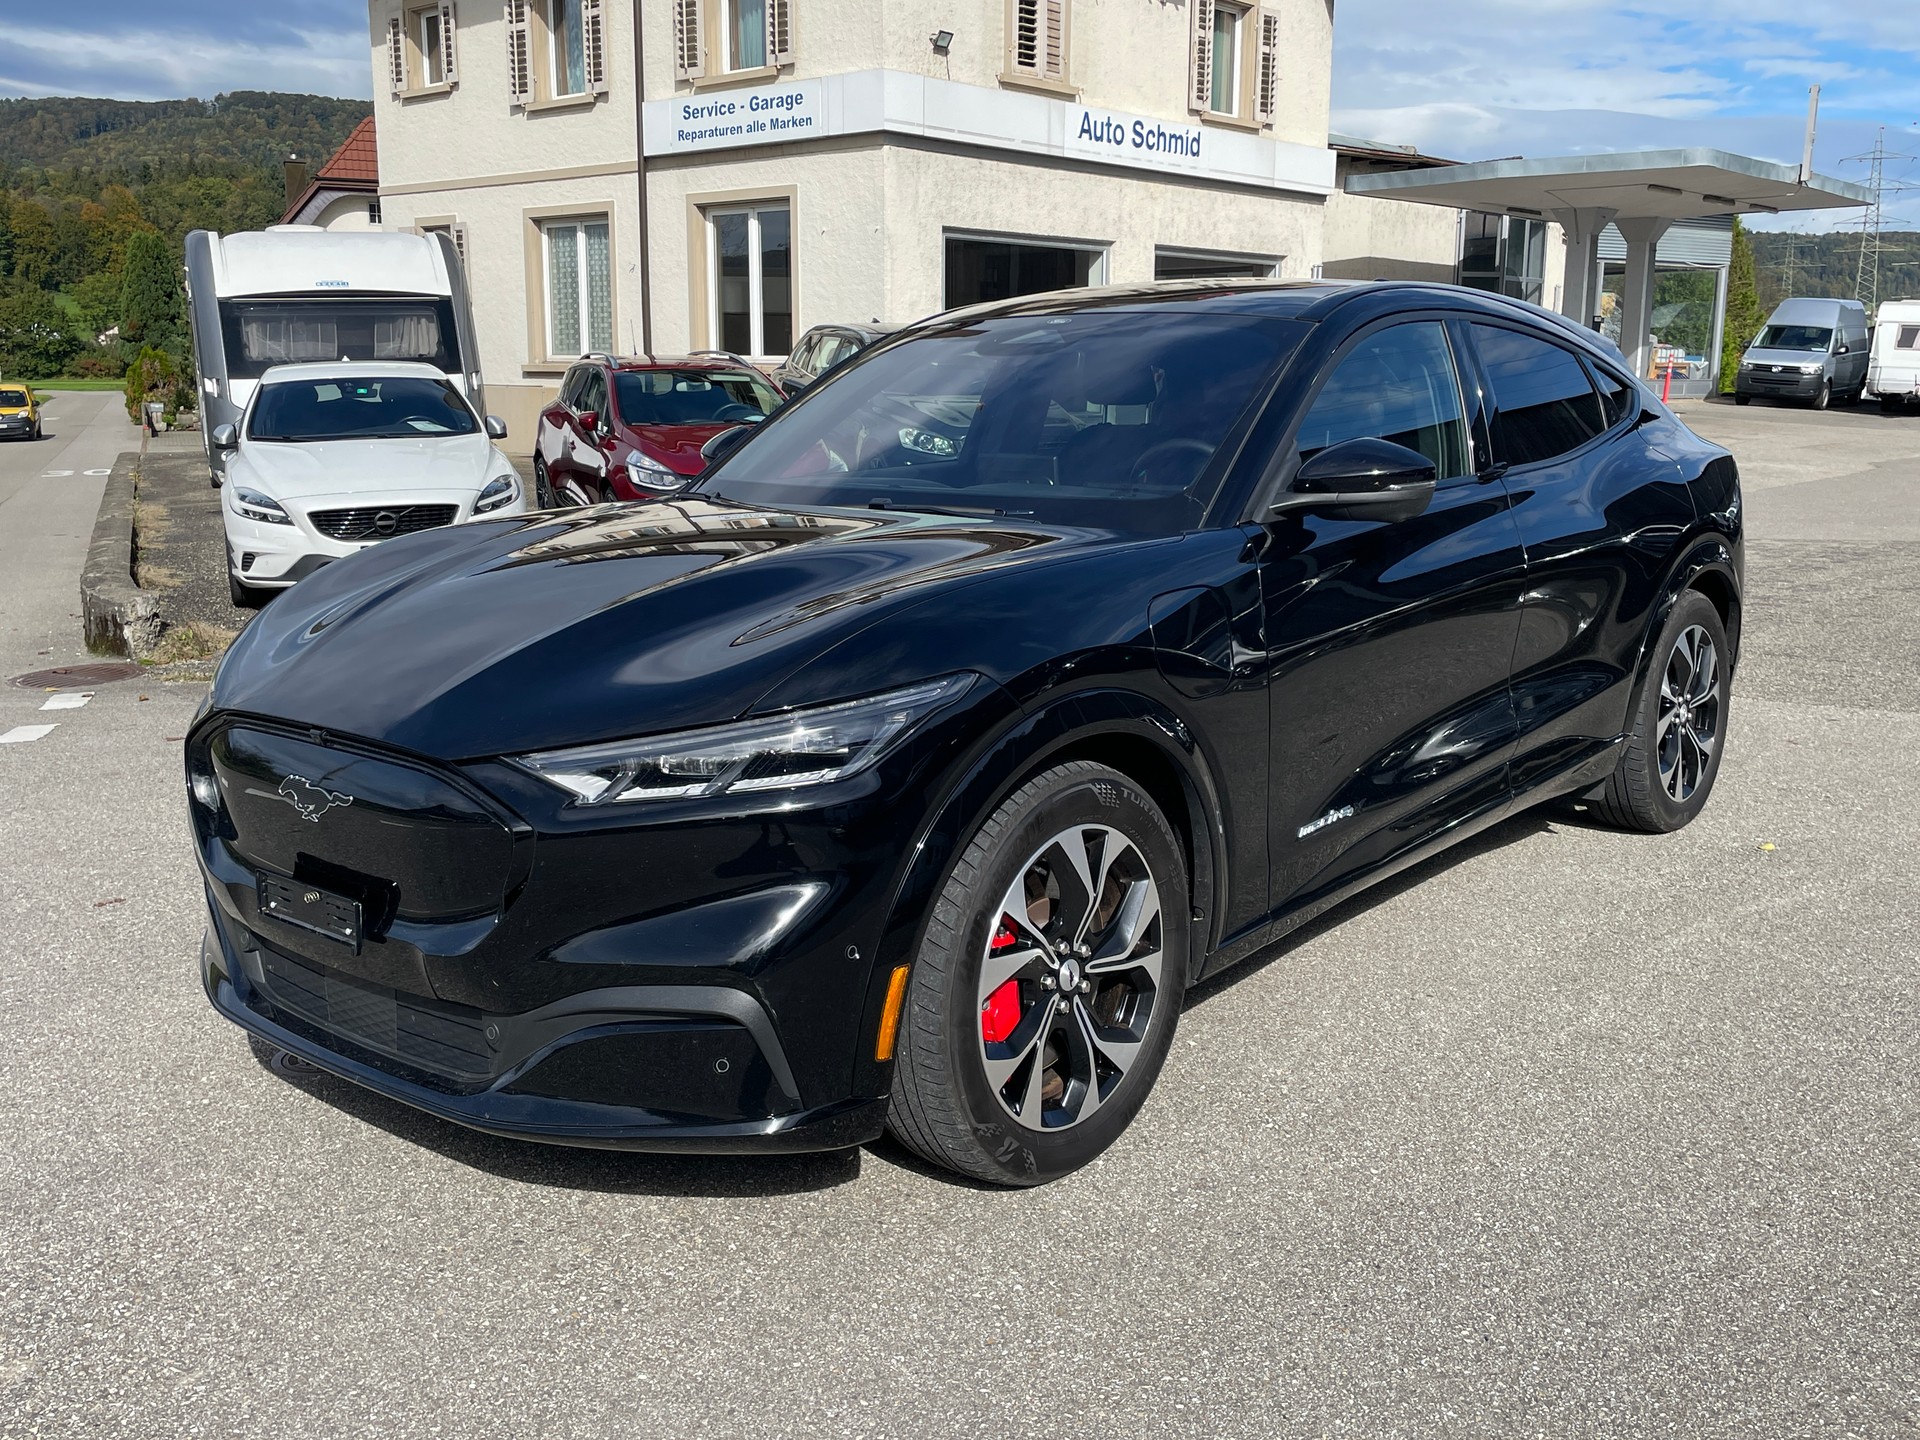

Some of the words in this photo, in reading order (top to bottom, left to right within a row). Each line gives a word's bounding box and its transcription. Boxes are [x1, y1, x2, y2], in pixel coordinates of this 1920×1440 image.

[683, 101, 736, 120] Service
[749, 92, 804, 111] Garage
[677, 125, 743, 142] Reparaturen
[746, 120, 767, 133] alle
[770, 116, 813, 131] Marken
[1078, 111, 1125, 145] Auto
[1132, 120, 1201, 157] Schmid
